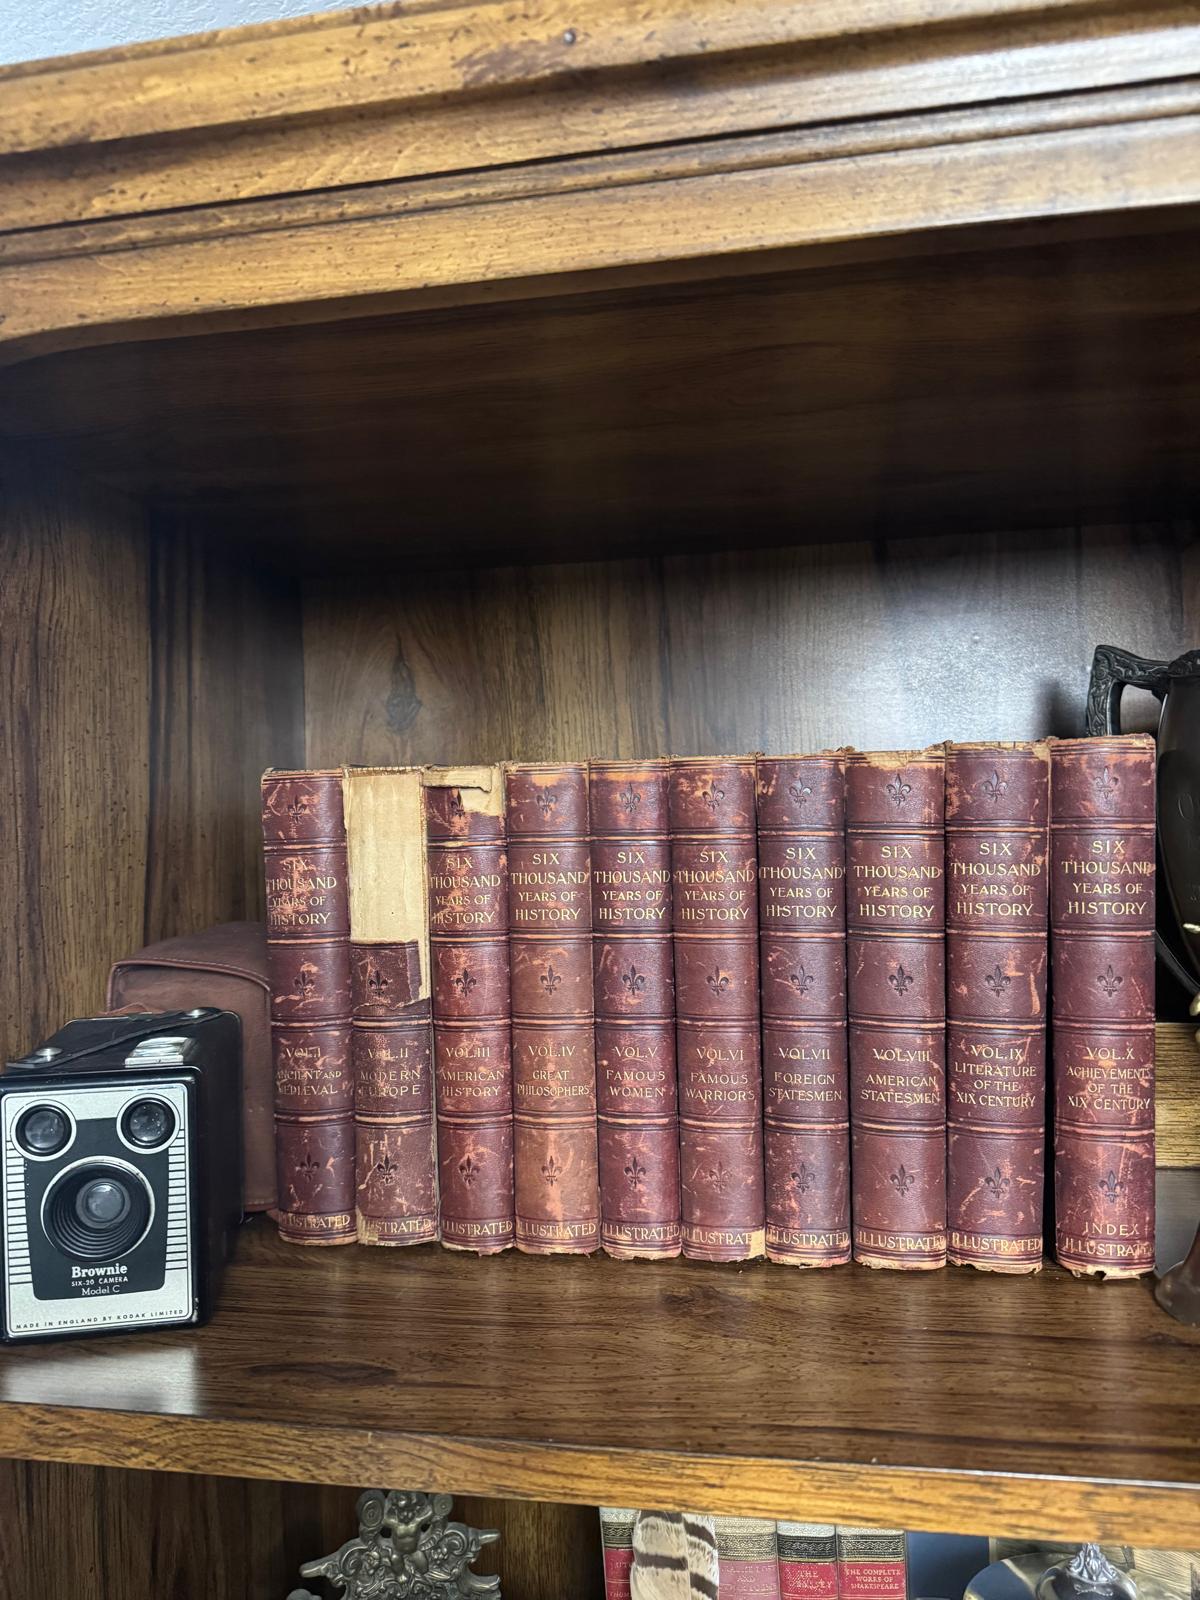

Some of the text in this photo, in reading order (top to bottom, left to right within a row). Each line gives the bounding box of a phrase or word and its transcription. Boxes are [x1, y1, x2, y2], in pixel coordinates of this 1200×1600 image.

[785, 847, 816, 860] SIX
[881, 846, 912, 859] SIX
[979, 842, 1012, 856] SIX
[1092, 840, 1125, 854] SIX
[447, 857, 473, 869] SIX
[532, 853, 559, 865] SIX
[617, 852, 645, 864] SIX
[700, 851, 728, 864] SIX
[761, 866, 844, 880] THOUSAND
[853, 865, 942, 879] THOUSAND
[950, 862, 1041, 877] THOUSAND
[1061, 861, 1152, 877] THOUSAND
[430, 874, 501, 889] THOUSAND
[510, 871, 588, 885] THOUSAND
[594, 870, 671, 884] THOUSAND
[676, 870, 755, 884] THOUSAND
[770, 887, 834, 898] YEARS OF
[864, 885, 931, 898] YEARS OF
[961, 884, 1030, 896] YEARS OF
[1073, 882, 1143, 894] YEARS OF
[309, 895, 327, 906] OF
[435, 894, 491, 906] YEARS OF
[518, 891, 577, 902] YEARS OF
[602, 890, 662, 901] YEARS OF
[684, 890, 746, 901] YEARS OF
[515, 908, 581, 921] HISTORY
[599, 907, 666, 920] HISTORY
[681, 907, 749, 921] HISTORY
[766, 904, 837, 918] HISTORY
[860, 903, 935, 917] HISTORY
[957, 901, 1034, 916] HISTORY
[1068, 901, 1146, 915] HISTORY
[270, 912, 331, 925] HISTORY
[432, 911, 494, 924] HISTORY
[528, 1046, 576, 1057] VOL.IV
[614, 1047, 658, 1058] VOL.V
[696, 1048, 744, 1061] VOL.VI
[779, 1048, 830, 1060] VOL.VII
[1086, 1046, 1135, 1060] VOL.X
[323, 1070, 342, 1079] AND
[360, 1069, 420, 1081] MODERN
[441, 1070, 505, 1081] AMERICAN
[532, 1070, 570, 1080] GREAT
[606, 1070, 665, 1081] FAMOUS
[955, 1062, 1036, 1077] LITERATURE
[690, 1072, 748, 1085] FAMOUS
[774, 1072, 836, 1085] FOREIGN
[865, 1074, 937, 1087] AMERICAN
[517, 1085, 590, 1096] PHILOSOPHERS
[609, 1086, 664, 1098] WOMEN
[974, 1079, 1019, 1092] OF THE
[1087, 1083, 1133, 1094] OF THE
[685, 1088, 755, 1101] WARRIORS
[769, 1087, 842, 1101] STATESMEN
[860, 1090, 940, 1104] STATESMEN
[956, 1092, 1036, 1108] XIX CENTURY
[1068, 1095, 1151, 1110] XIX CENTURY
[1084, 1221, 1139, 1236] INDEX
[71, 1263, 128, 1278] Brownie
[71, 1276, 129, 1287] SIX-20 CAMERA
[81, 1284, 120, 1296] Model C
[58, 1317, 98, 1325] ENGLAND
[151, 1309, 183, 1317] LIMITED
